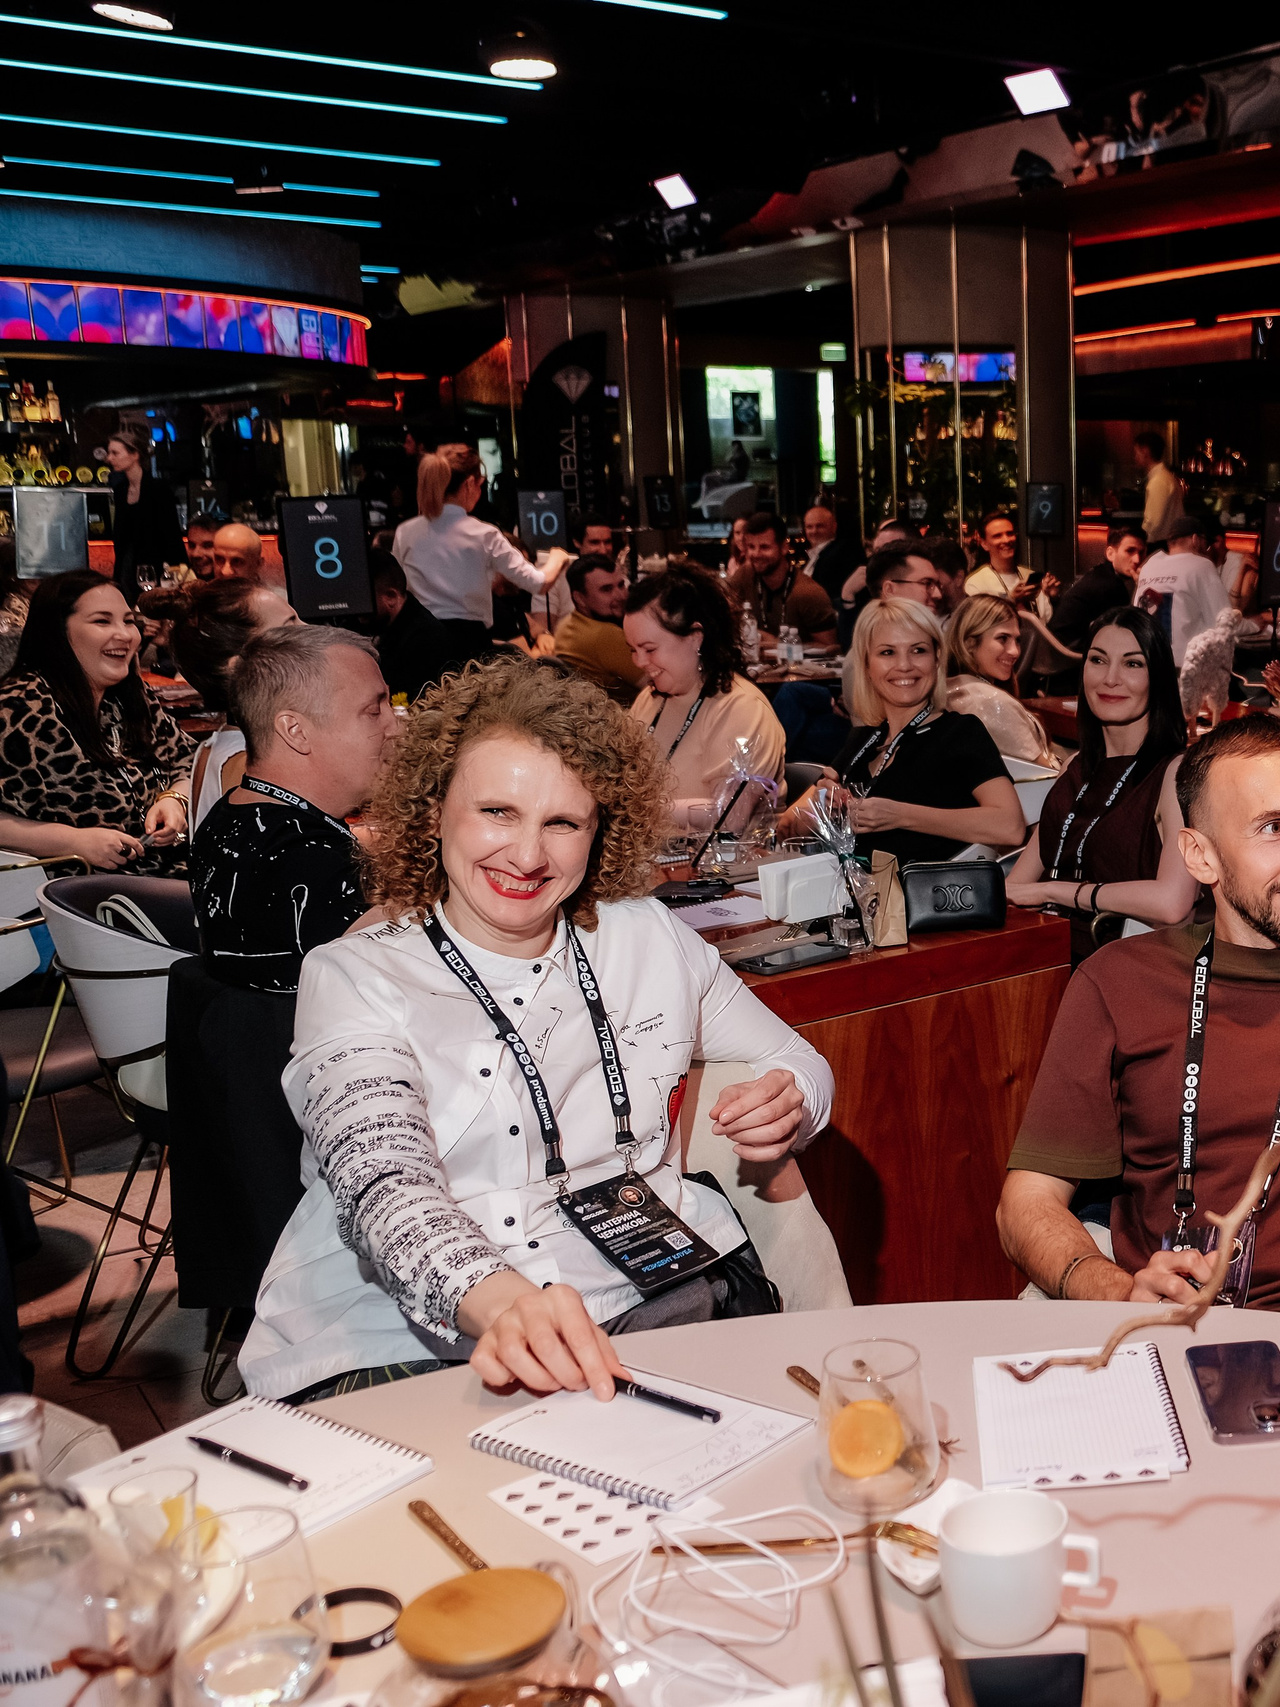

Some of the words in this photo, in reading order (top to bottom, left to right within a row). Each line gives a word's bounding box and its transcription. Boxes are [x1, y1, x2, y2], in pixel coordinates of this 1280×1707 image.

[654, 494, 671, 513] 13
[1039, 501, 1051, 520] 9
[527, 511, 559, 537] 10
[314, 537, 343, 579] 8
[248, 779, 301, 806] EDGLOBAL
[445, 951, 495, 1015] EDGLOBAL
[1190, 966, 1207, 1039] EDGLOBAL
[598, 1020, 624, 1094] EDGLOBAL
[529, 1079, 553, 1131] prodamus
[1182, 1116, 1193, 1169] prodamus
[590, 1209, 642, 1234] ЕКАТЕРИНА
[597, 1215, 652, 1240] ЧЕРНИКОВА
